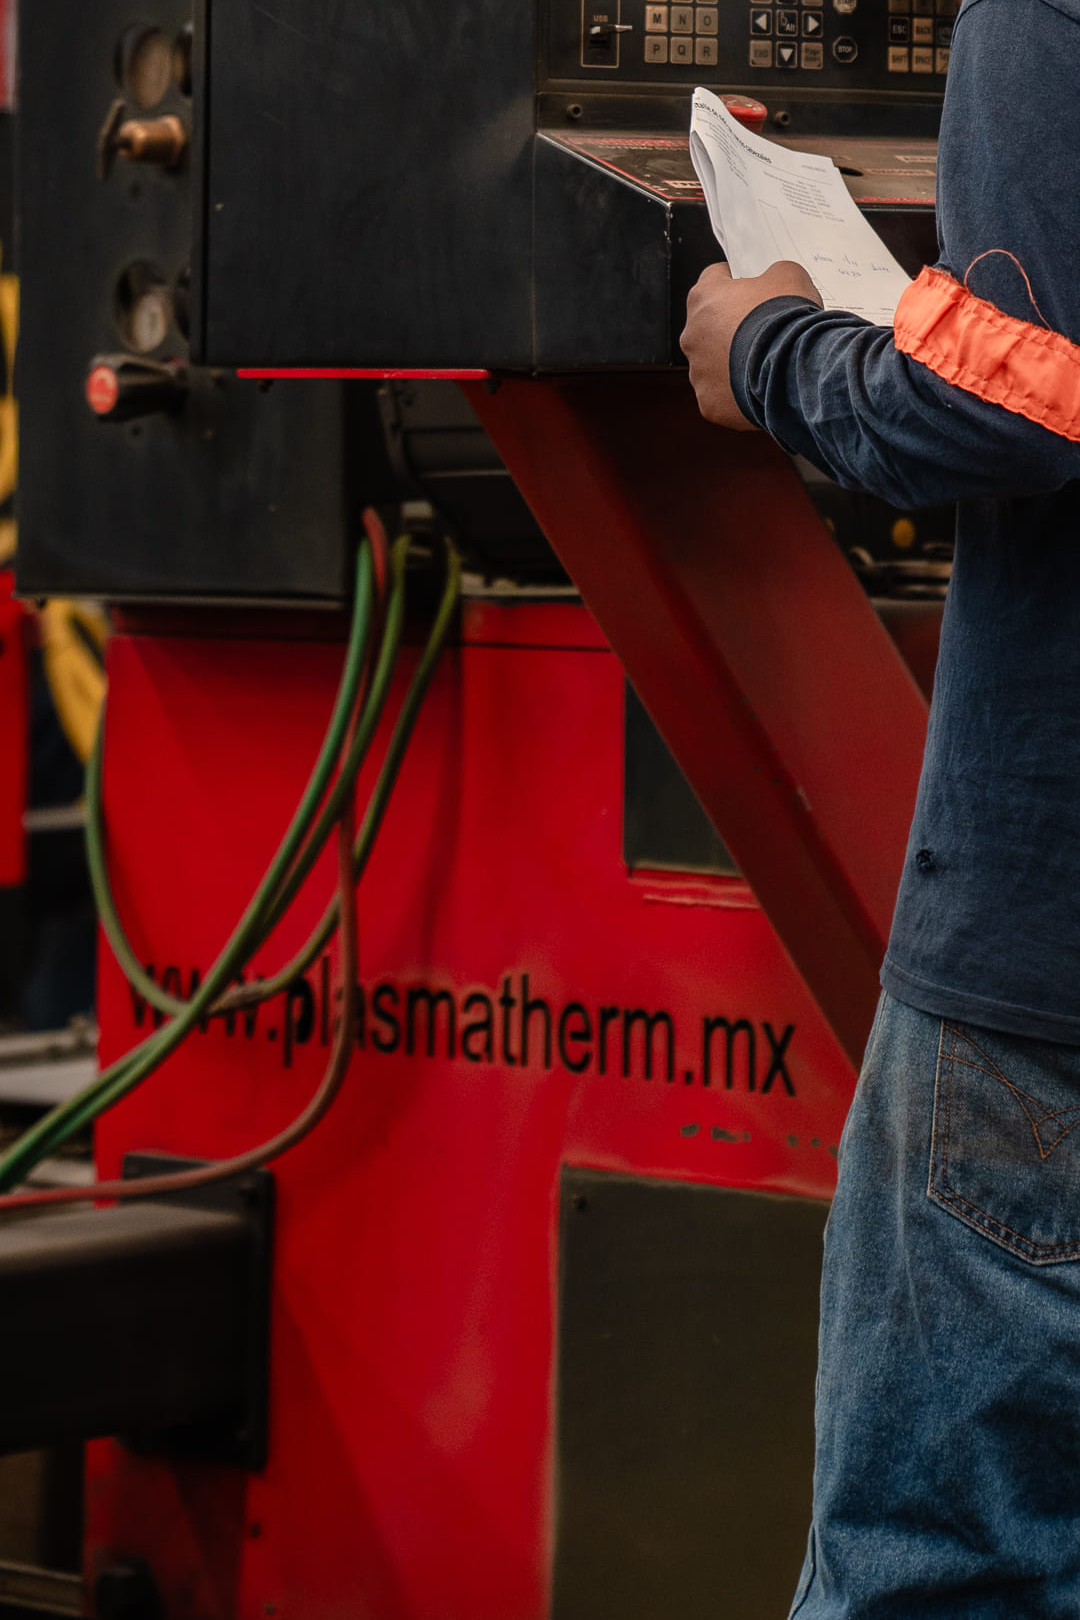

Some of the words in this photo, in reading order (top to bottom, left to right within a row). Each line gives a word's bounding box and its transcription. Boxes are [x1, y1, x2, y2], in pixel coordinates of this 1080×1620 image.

[593, 14, 609, 22] USB
[653, 13, 662, 24] M
[679, 14, 687, 25] N
[653, 44, 661, 55] P
[677, 45, 686, 56] Q
[703, 46, 711, 57] R
[838, 45, 852, 53] STOP
[128, 955, 796, 1098] ww.plsmatherm.mx
